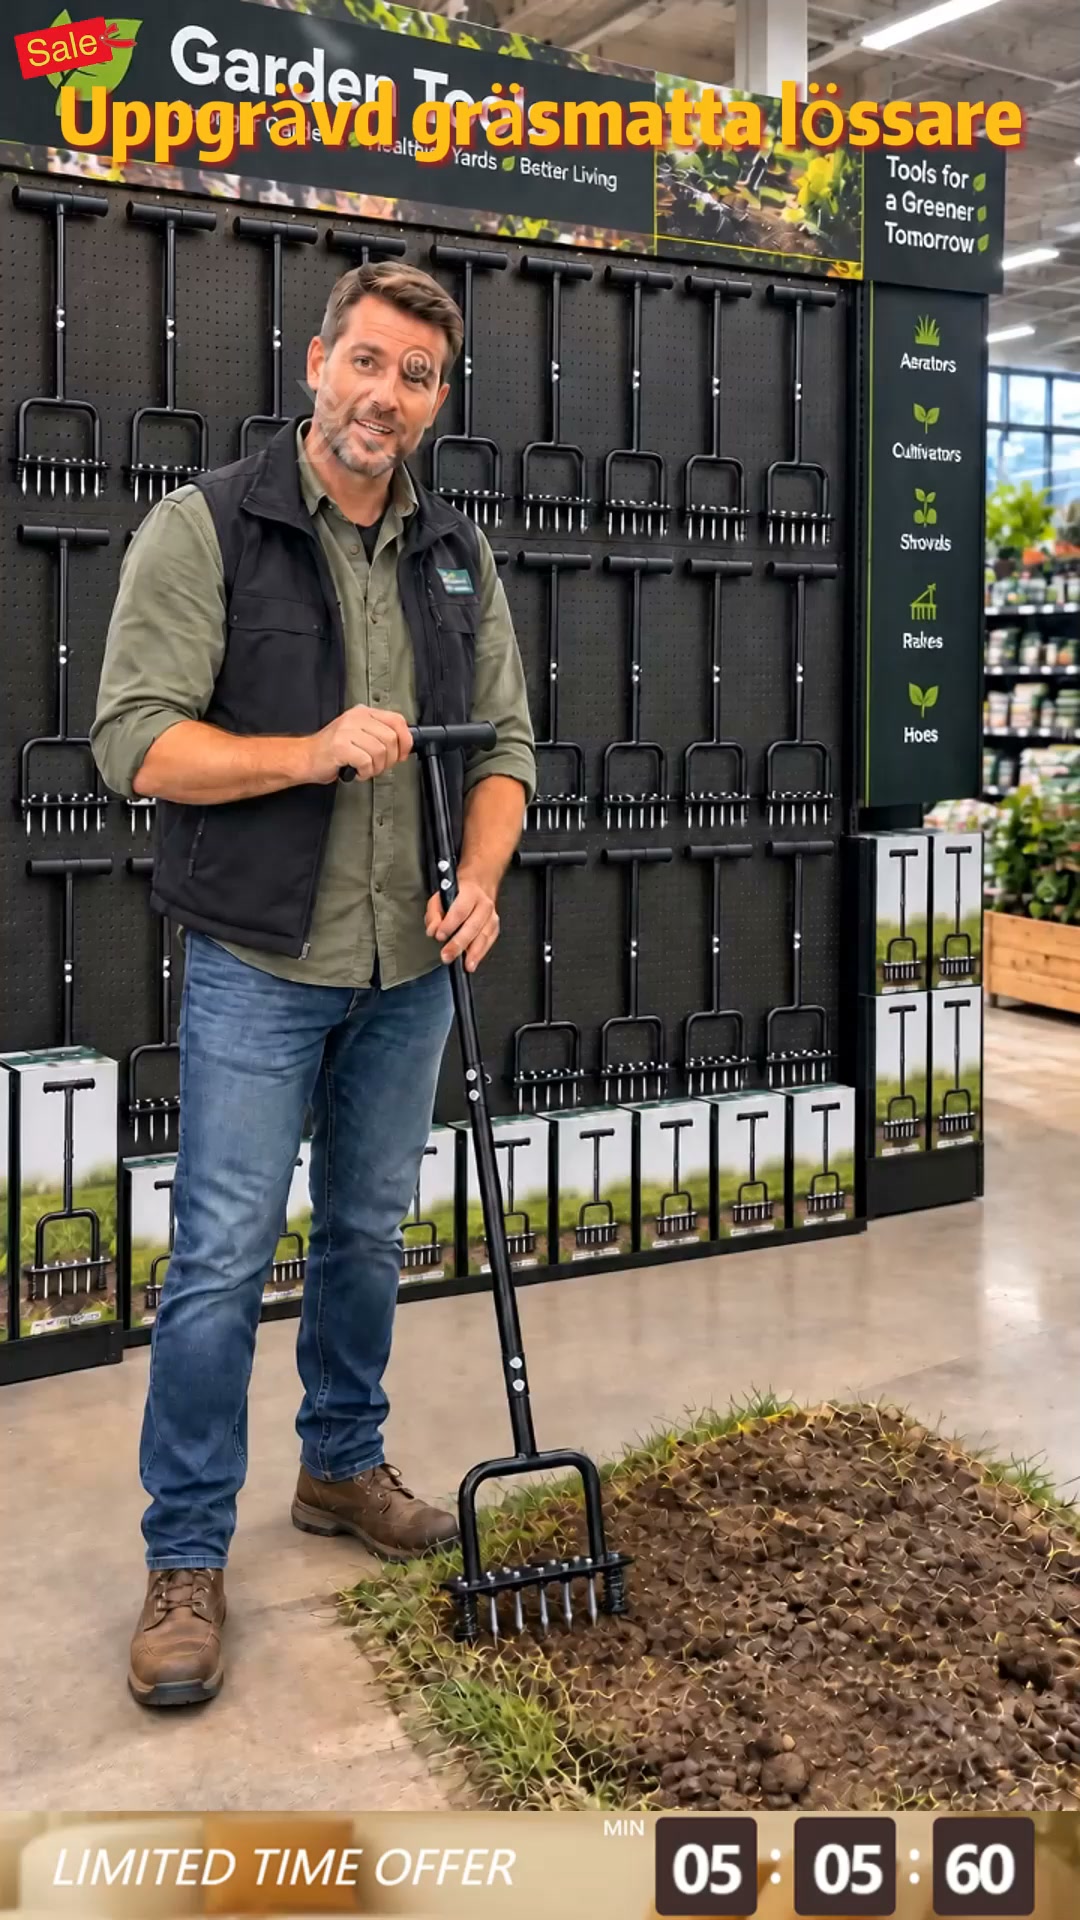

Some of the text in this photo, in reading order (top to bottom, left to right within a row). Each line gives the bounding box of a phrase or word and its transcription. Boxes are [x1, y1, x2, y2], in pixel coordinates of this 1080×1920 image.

[452, 146, 498, 170] Yards
[519, 156, 569, 181] Better
[572, 164, 618, 192] Living
[885, 154, 970, 189] Tools for
[885, 190, 975, 222] a Greener
[884, 220, 975, 254] Tomorrow
[903, 726, 939, 743] Hoes
